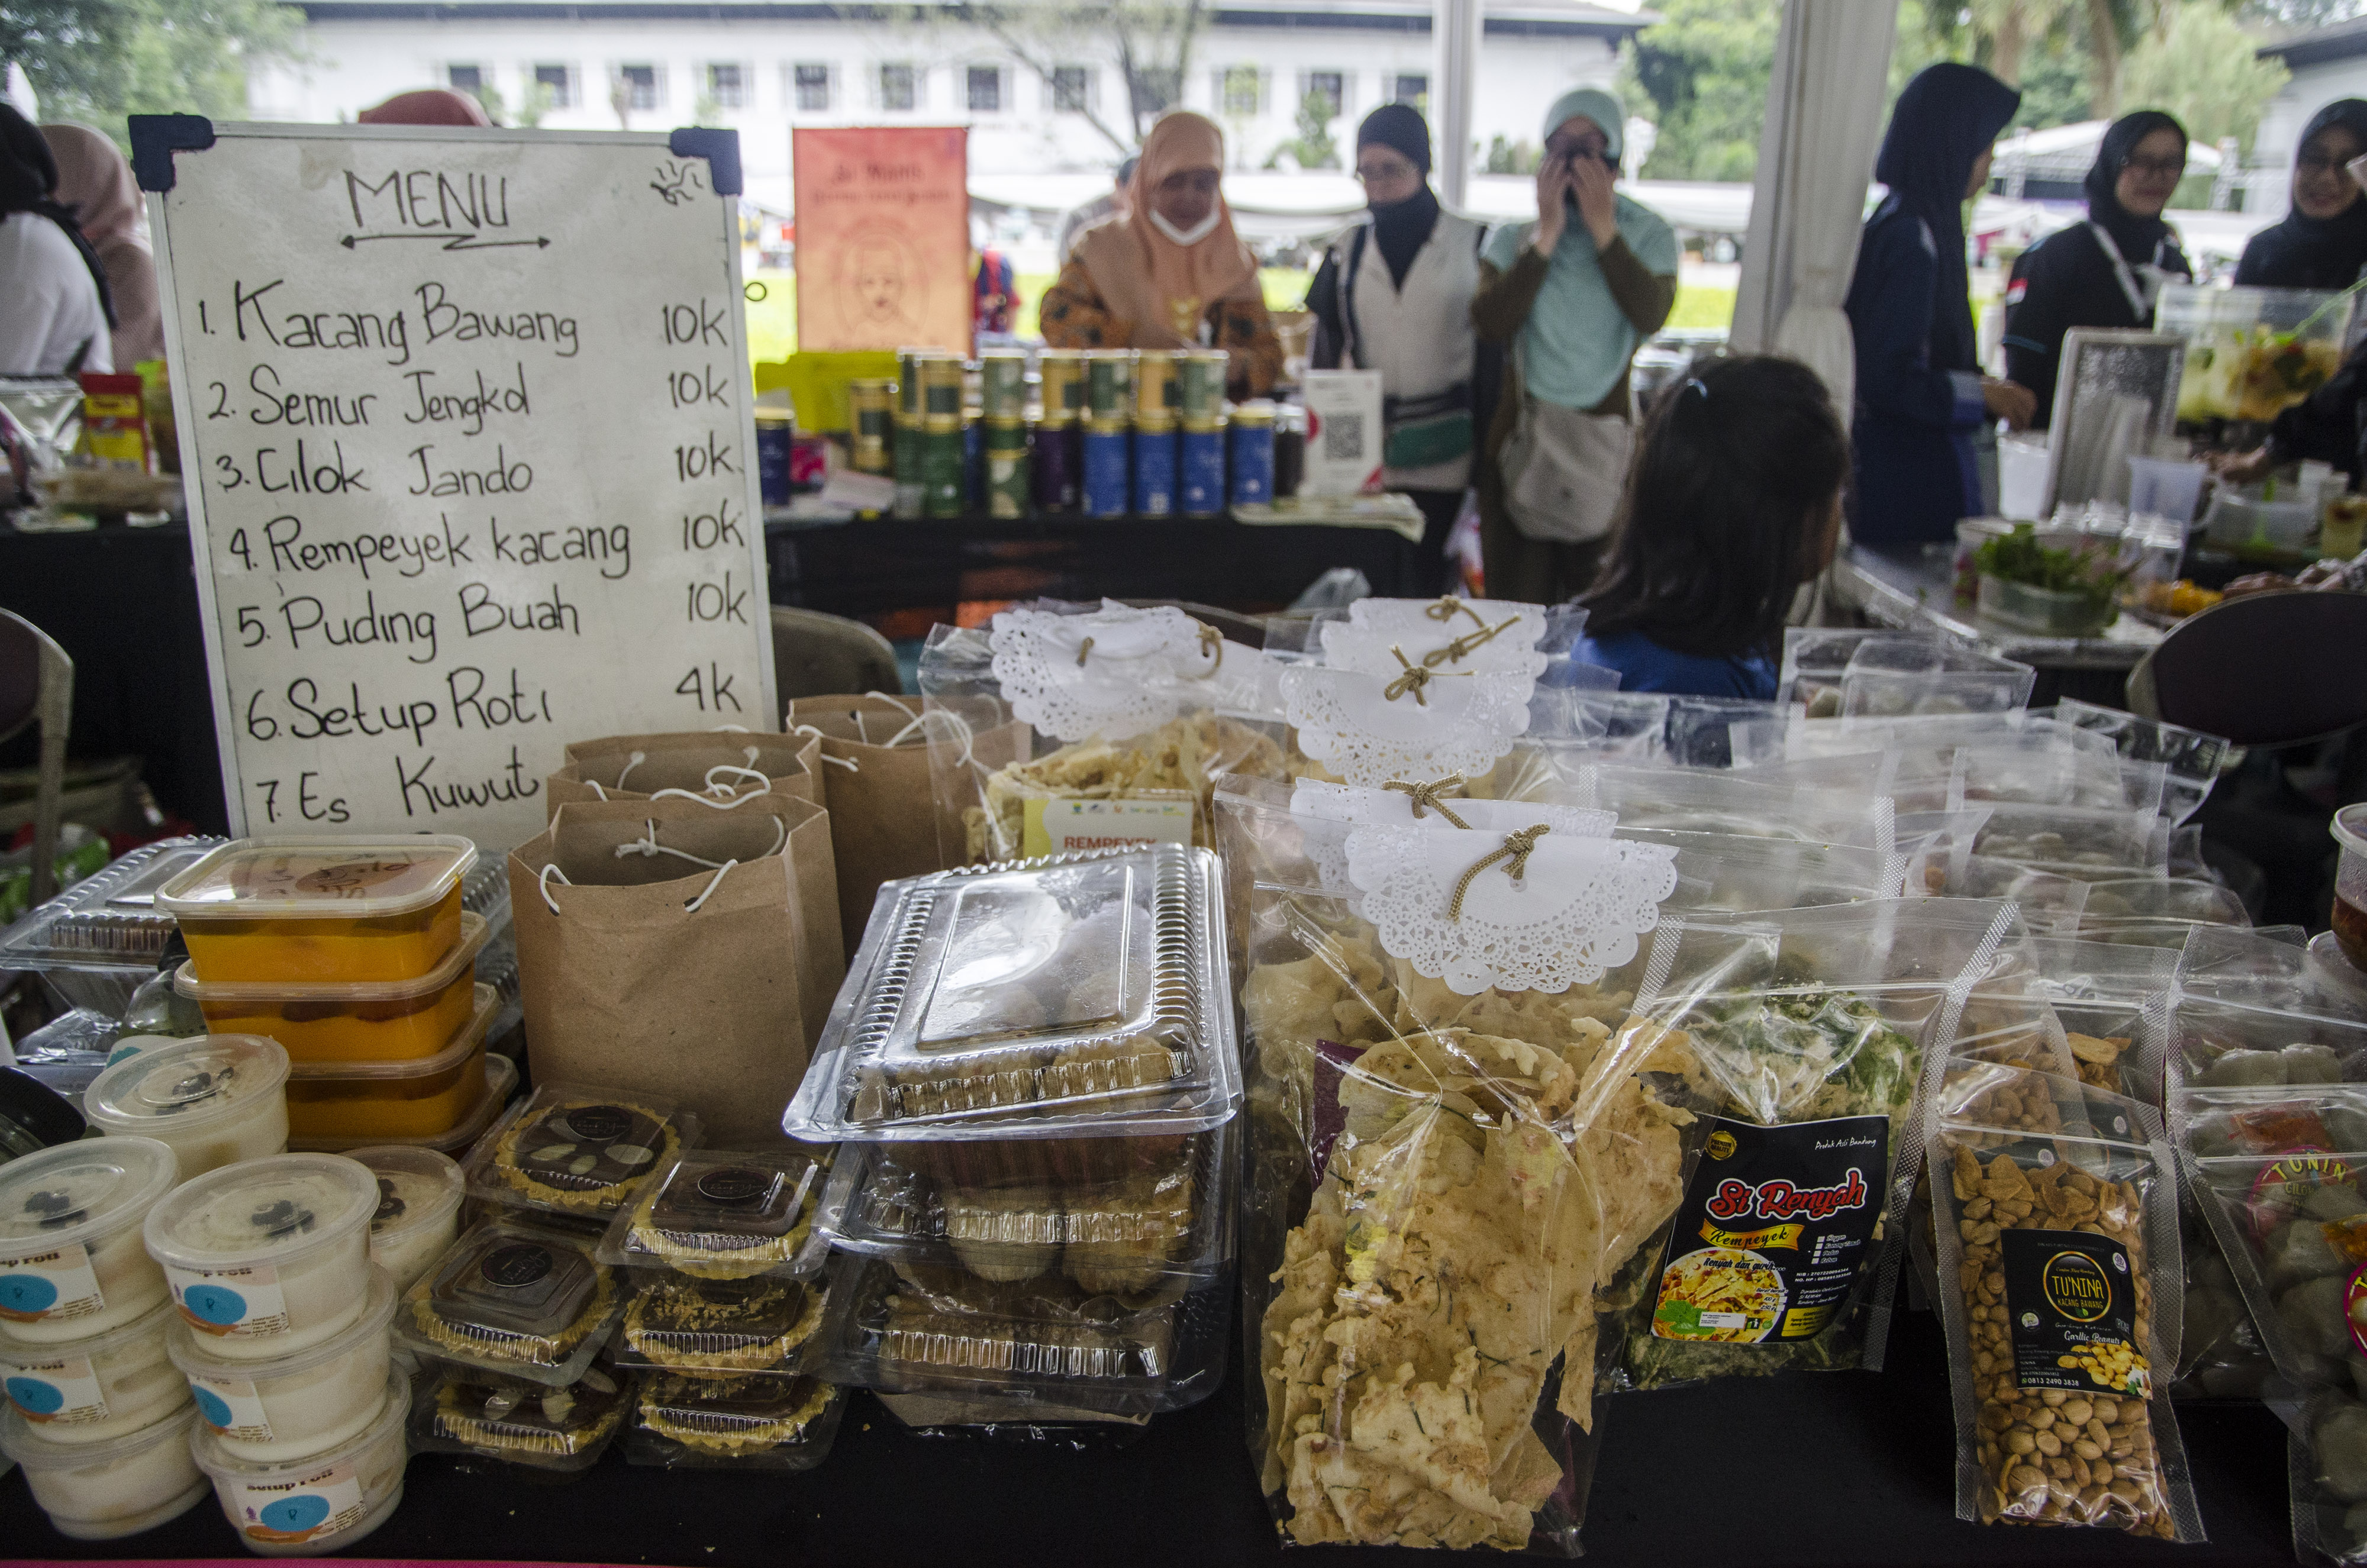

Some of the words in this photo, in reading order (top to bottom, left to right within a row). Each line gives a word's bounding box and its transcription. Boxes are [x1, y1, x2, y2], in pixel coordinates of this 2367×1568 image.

[344, 170, 509, 228] MENU
[199, 301, 215, 335] 1.
[236, 279, 409, 365] Kacang
[414, 282, 578, 356] Bawang
[662, 297, 728, 346] 10k
[208, 382, 237, 420] 2.
[250, 364, 378, 427] Semur
[668, 363, 729, 408] 10k
[216, 453, 250, 492] 3.
[256, 439, 370, 494] Cilok
[408, 444, 533, 496] Jando
[228, 528, 258, 572] 4.
[263, 512, 472, 578] Rempeyek
[237, 606, 272, 649] 5.
[279, 592, 438, 663] Puding
[458, 582, 581, 638] Buah
[247, 689, 283, 741] 6.
[287, 679, 438, 748] Setup
[446, 667, 552, 730] Roti
[256, 781, 282, 824] 7.
[299, 772, 351, 823] Es
[396, 744, 540, 817] Kuwut
[1815, 1140, 1834, 1150] Produk
[1836, 1139, 1849, 1148] Asli
[1849, 1135, 1876, 1148] Bandung
[1708, 1180, 1753, 1218] Si
[1757, 1169, 1865, 1218] Renyah
[1704, 1257, 1733, 1269] Renyah
[1734, 1260, 1751, 1269] dan
[1710, 1227, 1789, 1251] Rempeyek
[2057, 1298, 2079, 1308] KACANG
[2080, 1299, 2104, 1309] BAWANG
[2092, 1333, 2120, 1345] Peanuts
